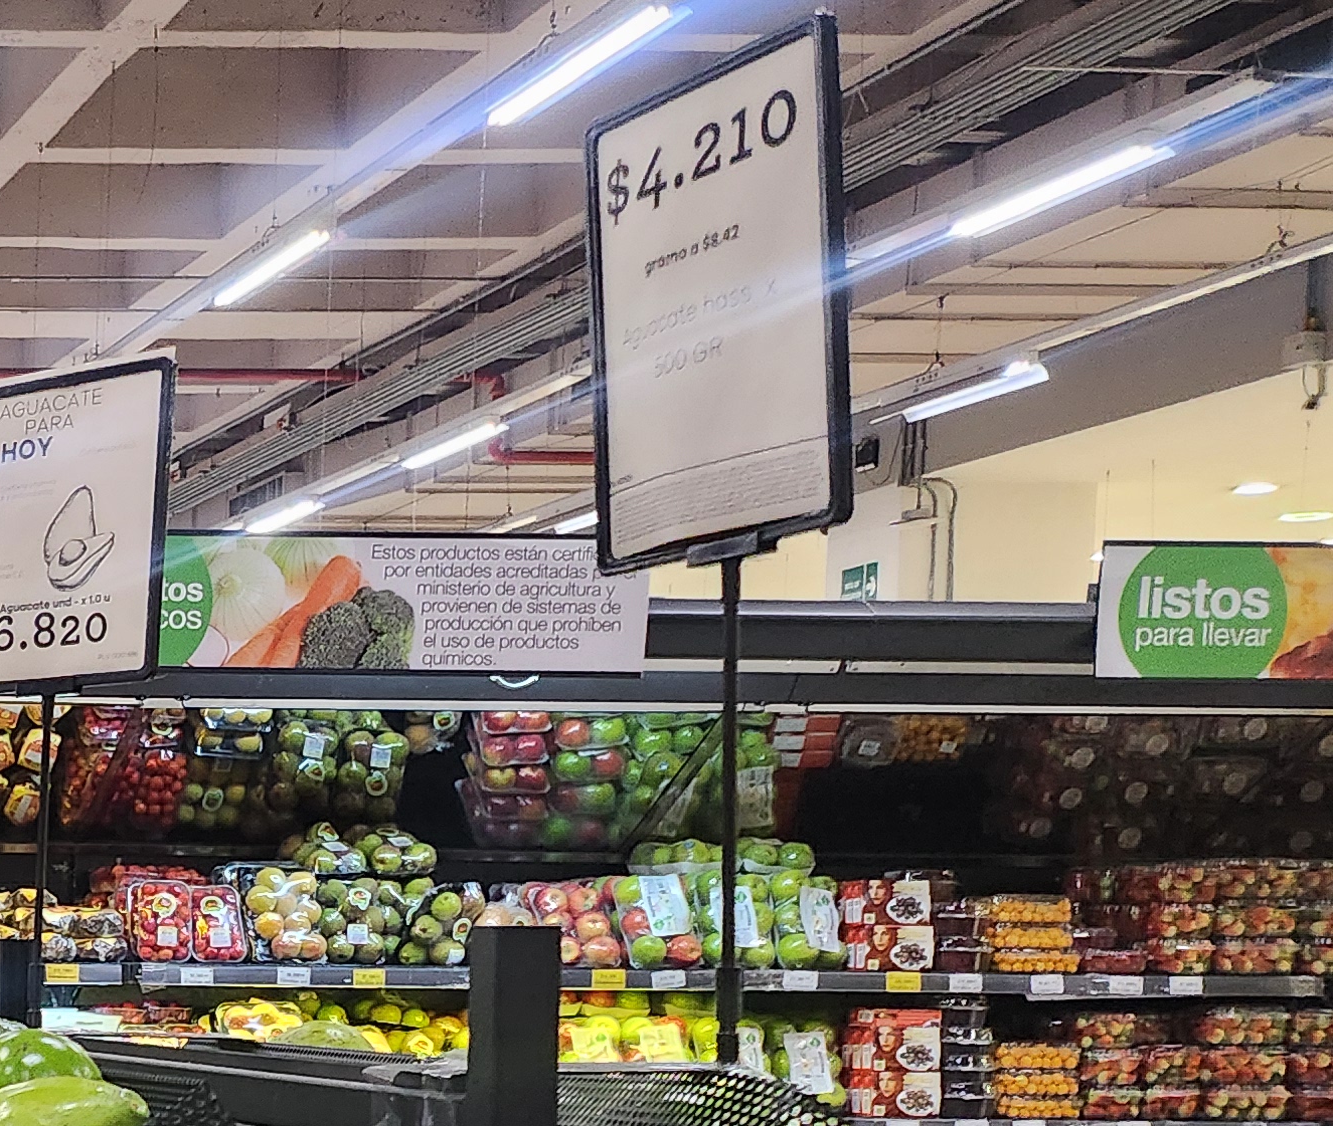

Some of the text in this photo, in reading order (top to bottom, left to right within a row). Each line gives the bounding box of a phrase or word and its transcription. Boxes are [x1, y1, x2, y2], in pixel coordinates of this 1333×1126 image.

[606, 88, 797, 226] $4.210
[0, 388, 103, 420] AGUACATE
[25, 414, 74, 436] PARA
[1, 436, 54, 463] HOY
[371, 544, 416, 560] Estos
[420, 544, 500, 564] productos
[504, 544, 549, 561] están
[384, 566, 411, 582] por
[415, 564, 492, 579] entidades
[496, 564, 589, 580] acreditadas
[416, 582, 616, 600] ministerio de agricultura y
[1138, 576, 1270, 620] listos
[421, 600, 622, 617] provienen de sistemas de
[424, 616, 622, 634] producción que prohíben
[423, 633, 579, 651] el uso de productos
[1135, 622, 1272, 651] para llevar
[422, 651, 497, 669] químicos.
